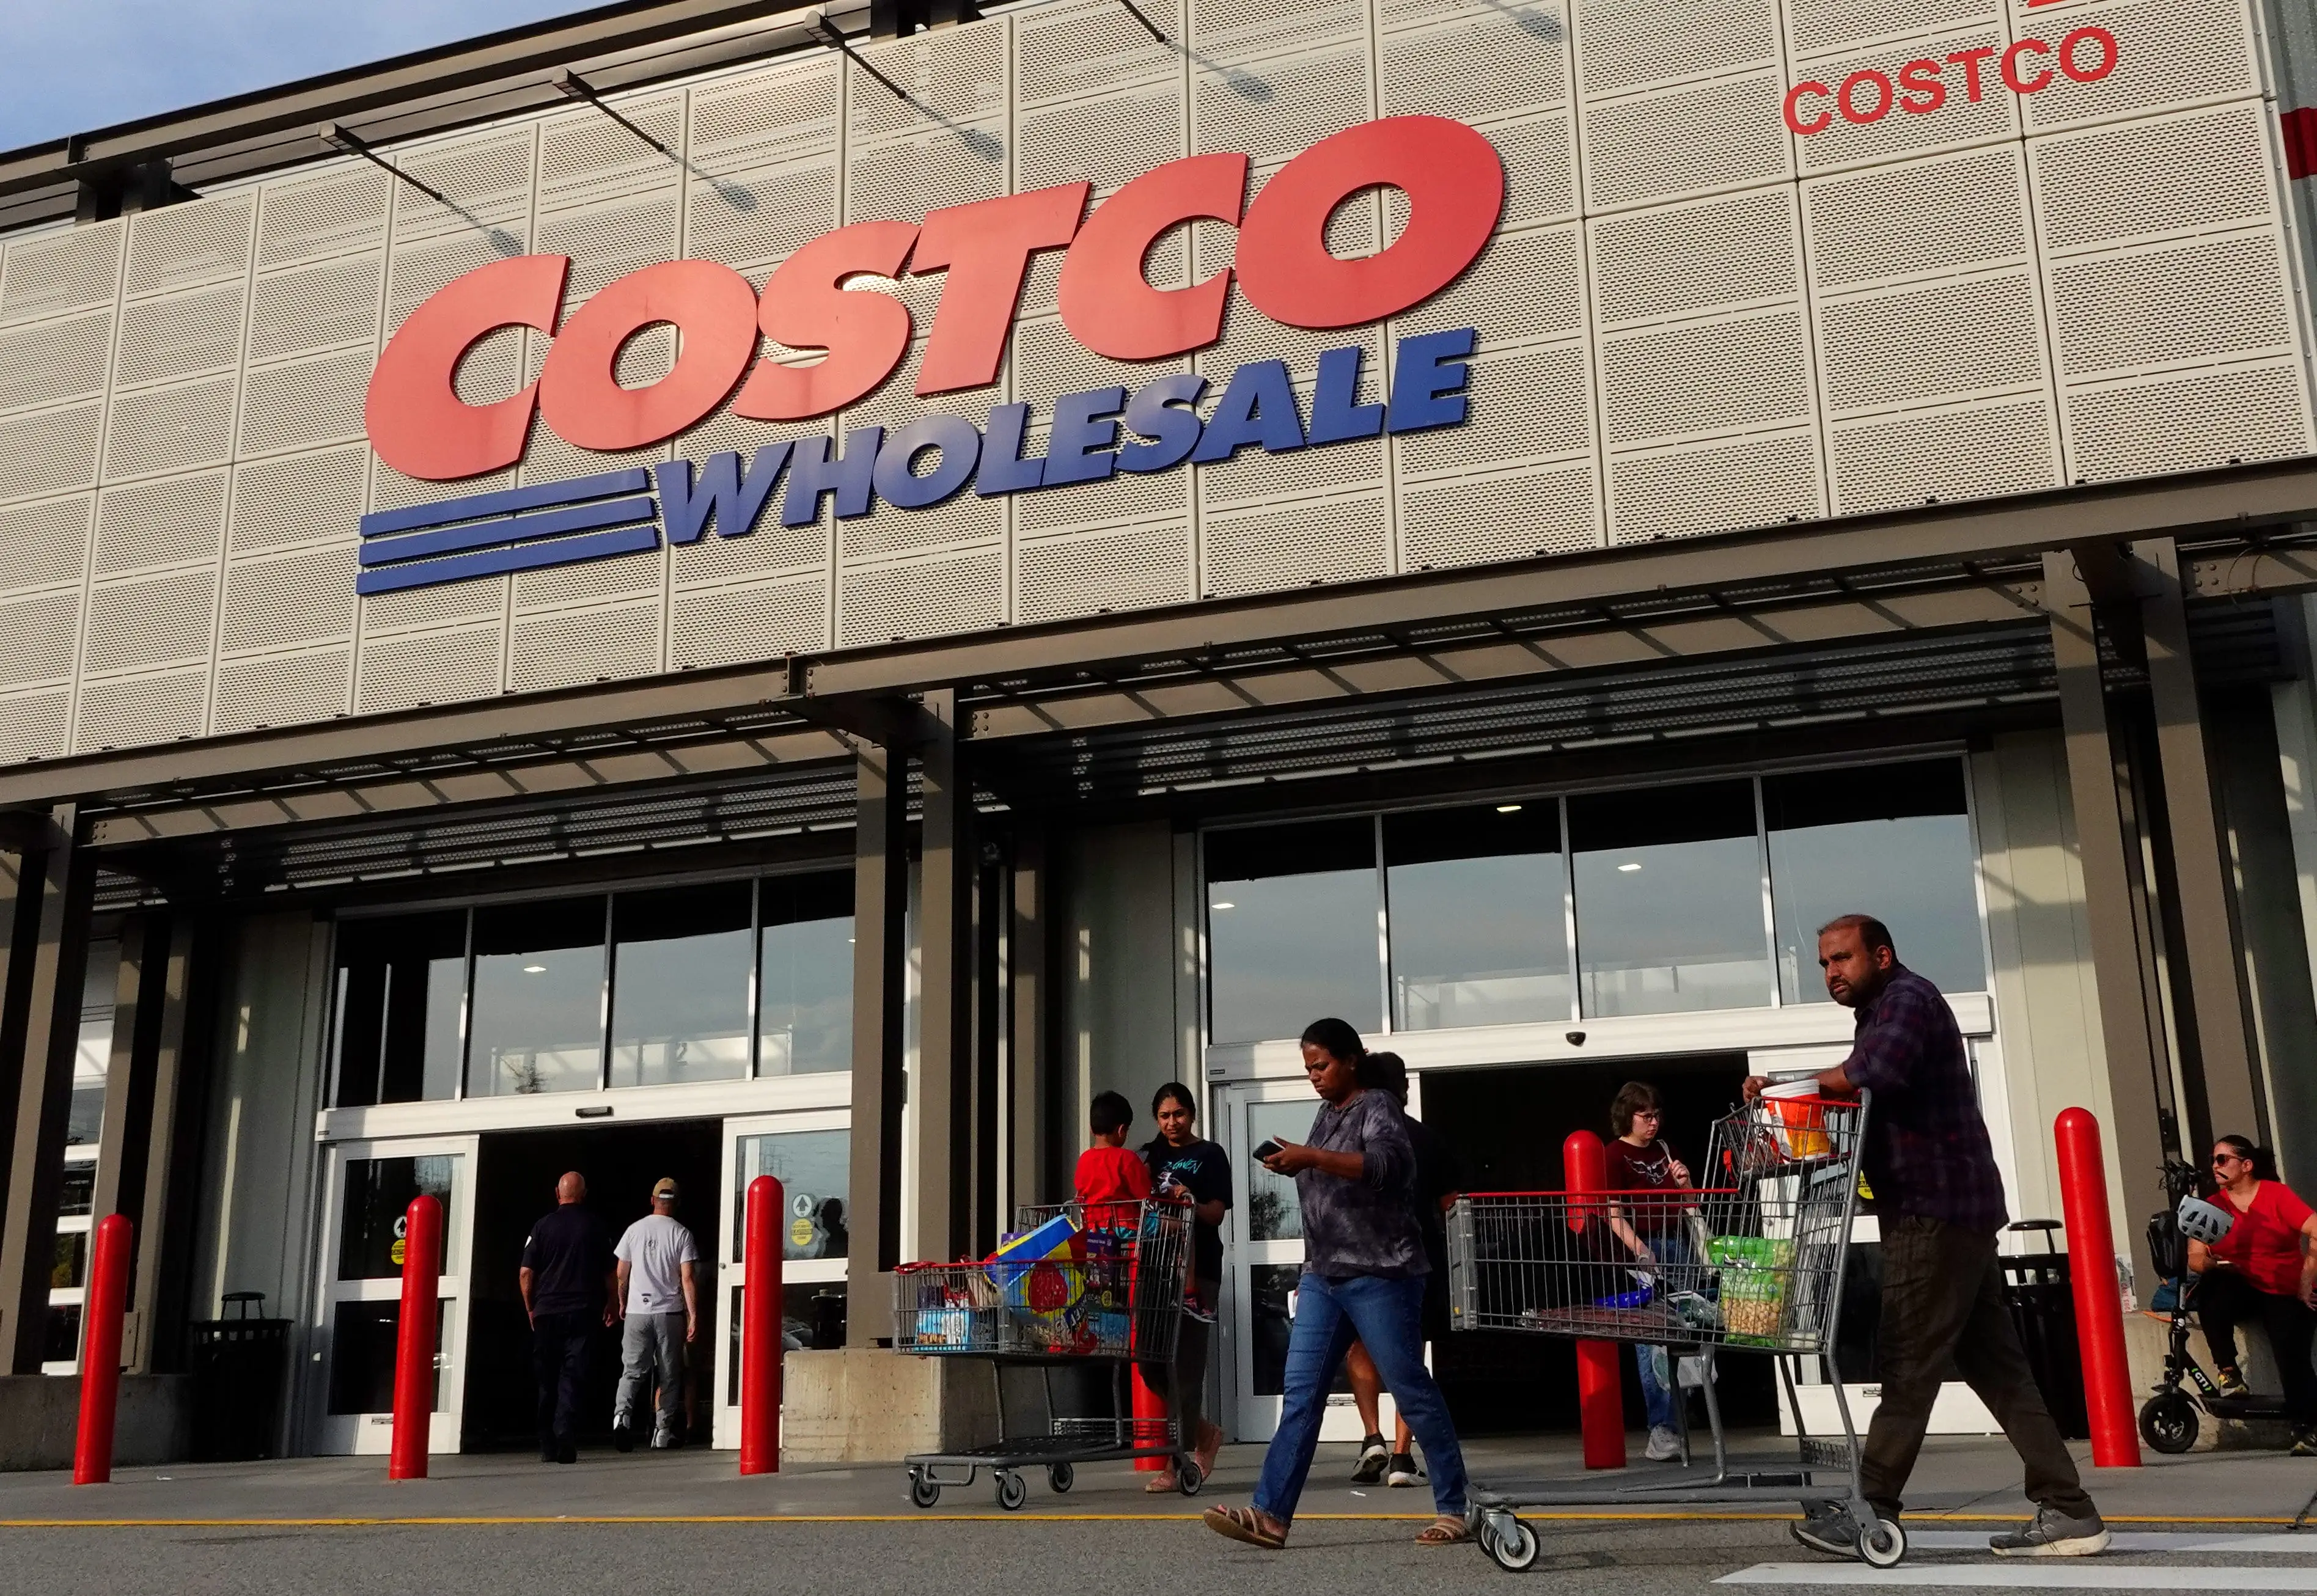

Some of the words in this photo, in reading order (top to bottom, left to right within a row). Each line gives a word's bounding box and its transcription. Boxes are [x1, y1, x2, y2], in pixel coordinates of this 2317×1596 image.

[1783, 26, 2118, 136] COSTCO
[365, 114, 1505, 481] COSTCO
[655, 327, 1475, 546] WHOLESALE
